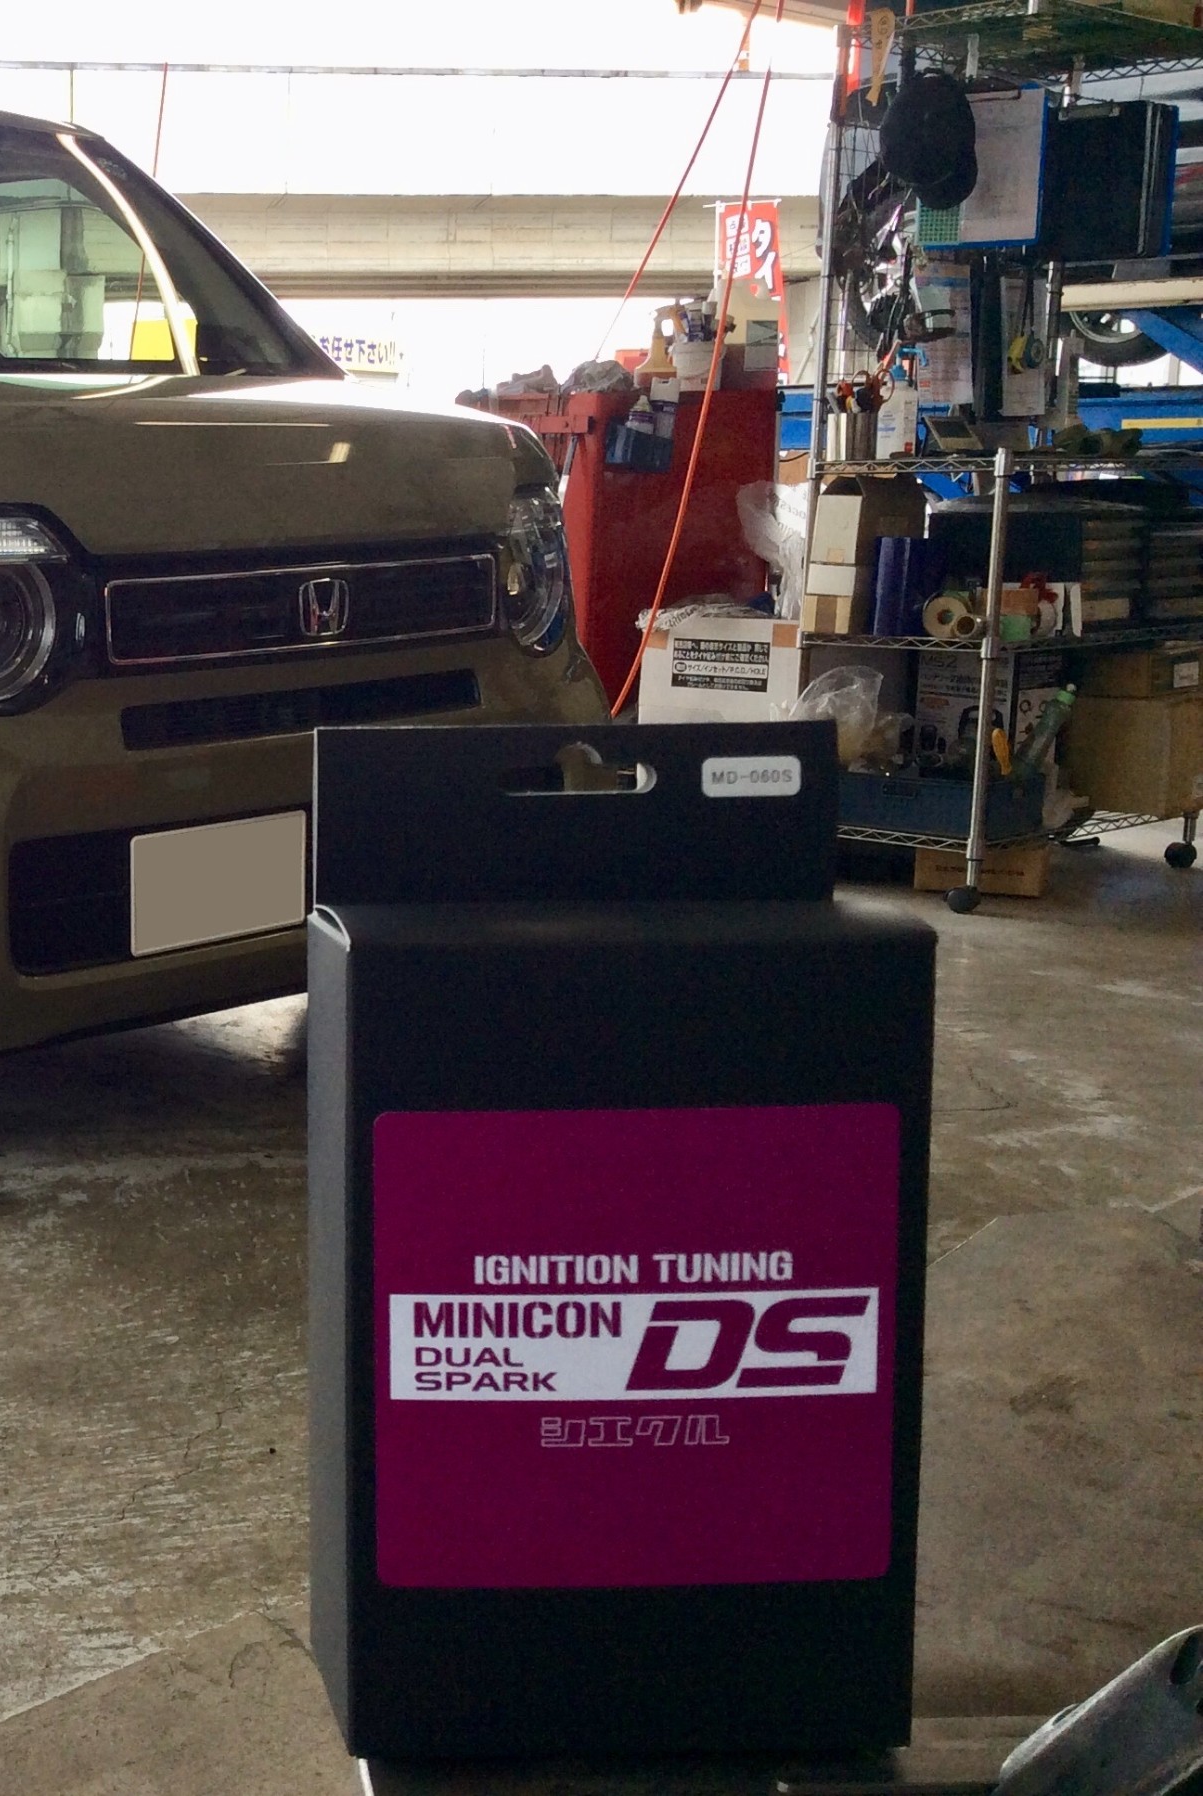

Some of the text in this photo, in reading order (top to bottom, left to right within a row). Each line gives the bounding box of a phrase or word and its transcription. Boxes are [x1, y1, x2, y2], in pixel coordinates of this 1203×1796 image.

[711, 769, 793, 785] MD-060S
[474, 1250, 794, 1286] IGNITION TUNING
[413, 1301, 623, 1340] MINICON
[414, 1346, 525, 1368] DUAL
[625, 1295, 871, 1392] DS
[414, 1371, 558, 1393] SPARK
[540, 1414, 730, 1448] シエクル
